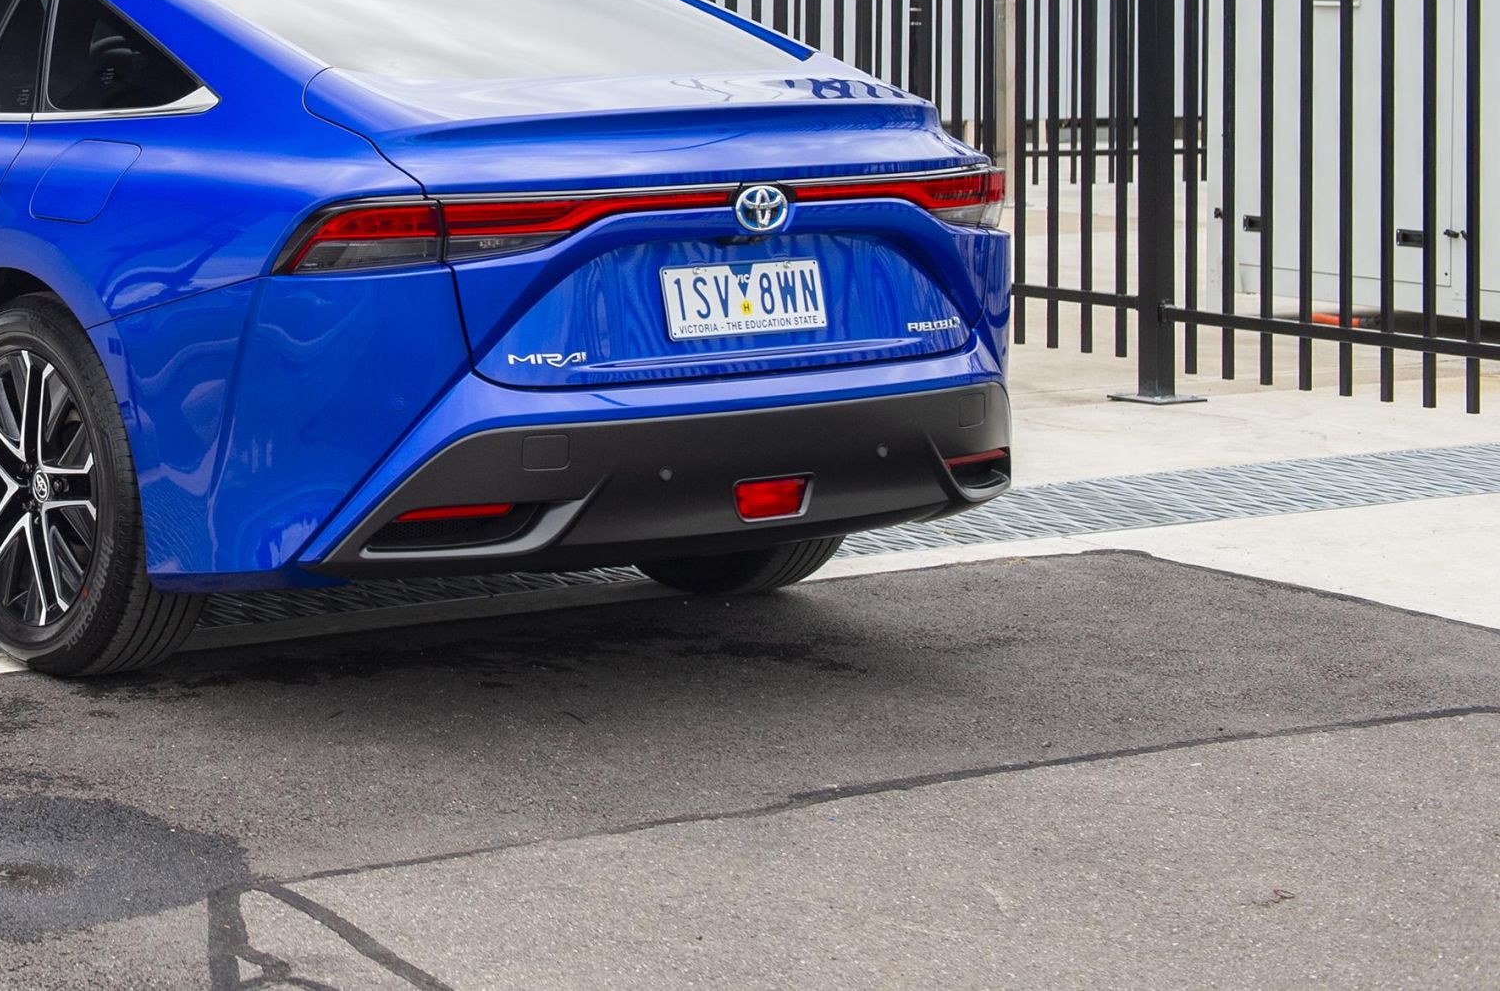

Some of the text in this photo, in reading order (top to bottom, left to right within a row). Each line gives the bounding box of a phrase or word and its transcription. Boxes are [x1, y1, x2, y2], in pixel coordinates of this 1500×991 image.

[673, 269, 820, 322] 1SV 8WN
[743, 304, 750, 312] H
[679, 323, 719, 335] VICTORIA
[726, 321, 743, 331] THE
[745, 318, 792, 330] EDUCATION
[794, 315, 819, 325] STATE
[507, 351, 587, 367] MIRAI
